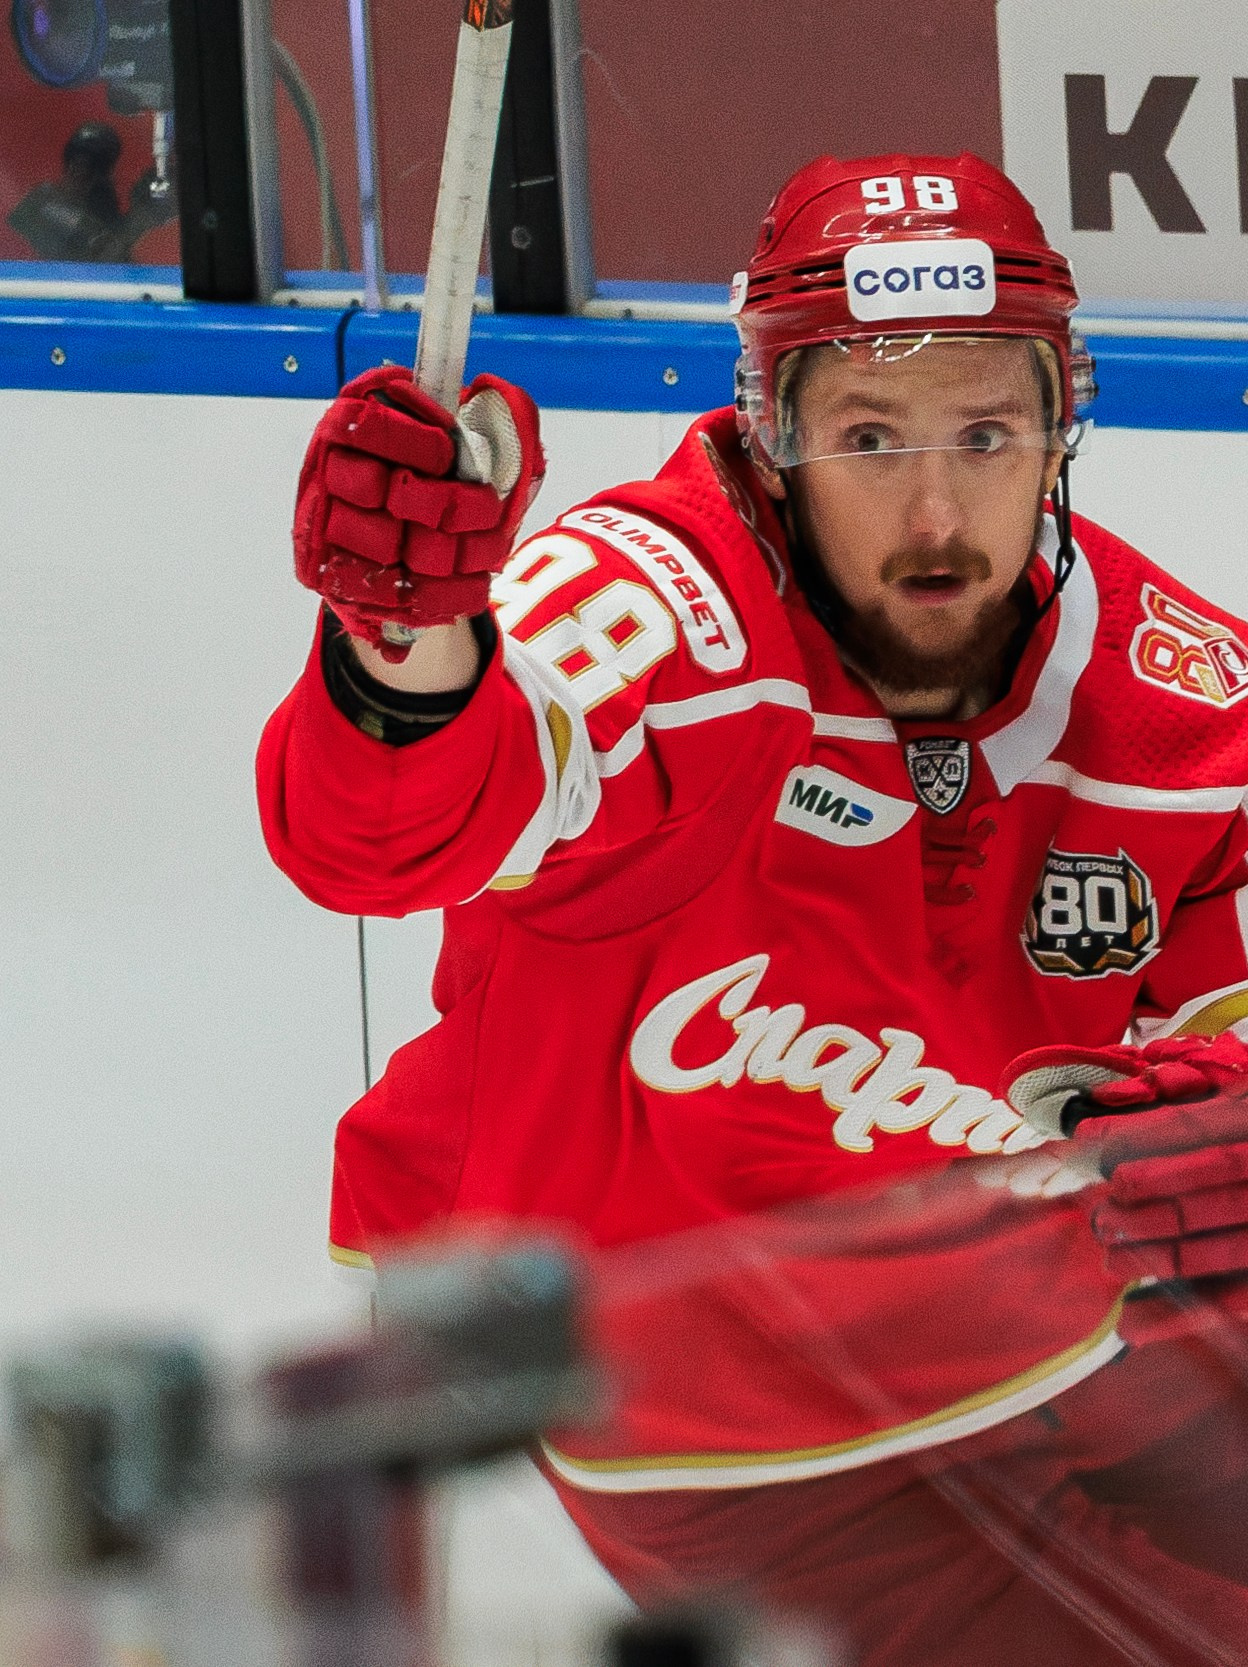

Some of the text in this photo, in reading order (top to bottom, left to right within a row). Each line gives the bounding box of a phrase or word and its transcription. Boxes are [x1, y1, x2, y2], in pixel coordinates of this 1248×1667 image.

[860, 175, 959, 215] 98
[581, 512, 731, 650] OLIMPBET
[489, 533, 678, 716] 98
[789, 778, 875, 829] МИР
[1041, 873, 1128, 935] 80
